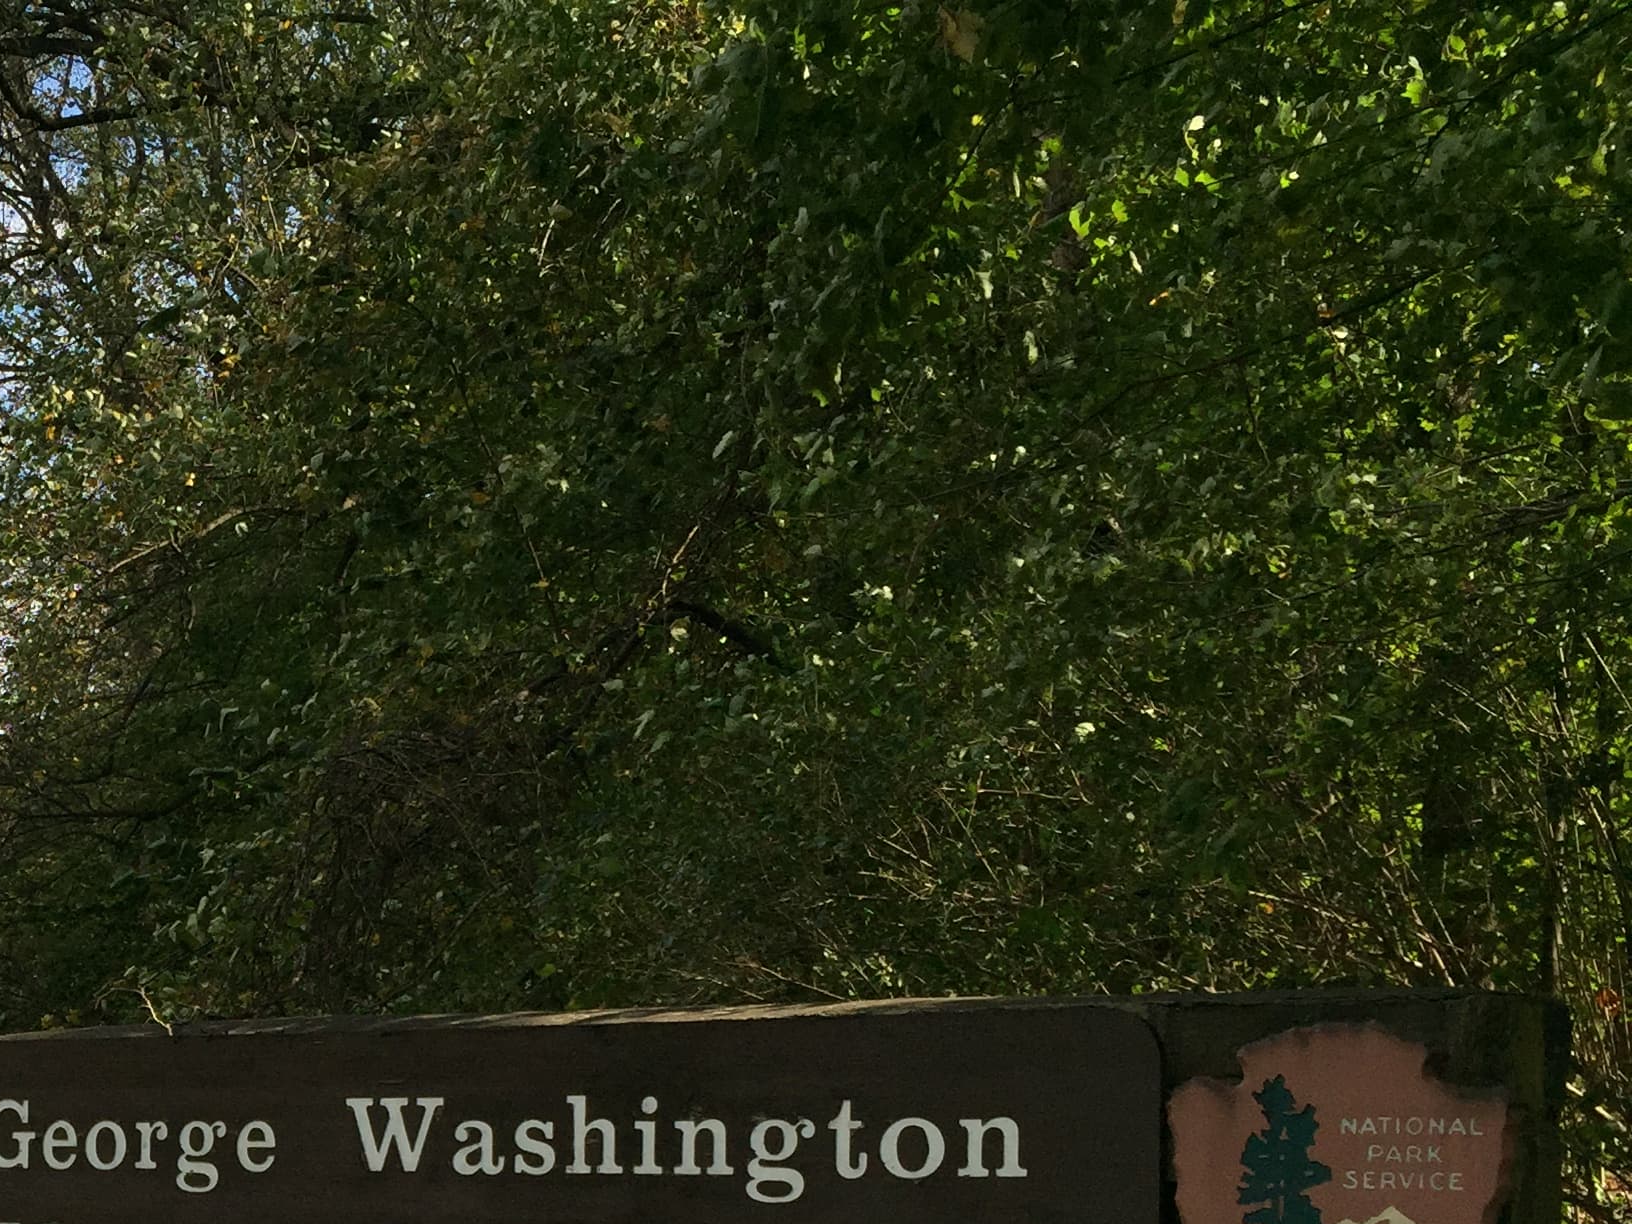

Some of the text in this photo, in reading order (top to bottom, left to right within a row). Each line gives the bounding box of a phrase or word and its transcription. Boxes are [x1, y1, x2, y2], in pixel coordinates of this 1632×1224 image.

[1340, 1116, 1484, 1136] NATIONAL
[344, 1094, 1029, 1204] Washington
[1367, 1144, 1443, 1163] PARK
[1342, 1170, 1464, 1191] SERVICE
